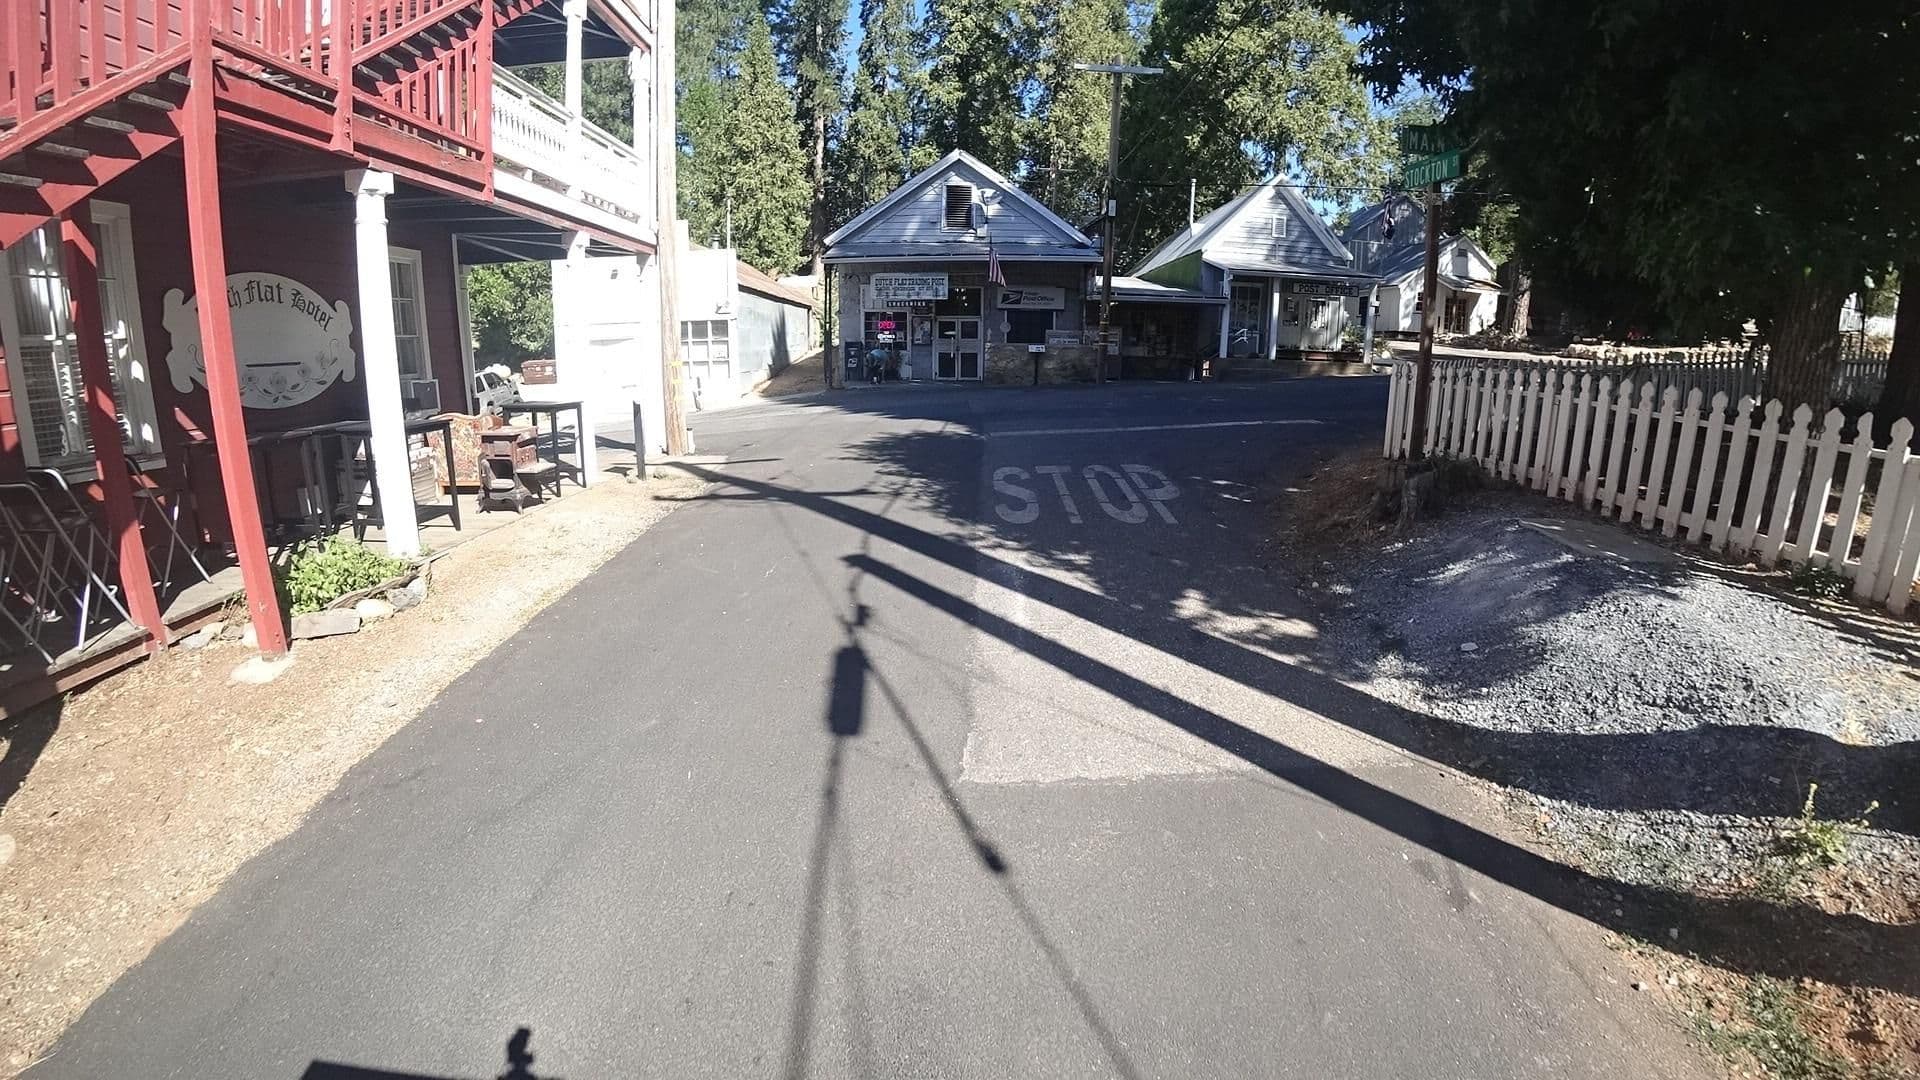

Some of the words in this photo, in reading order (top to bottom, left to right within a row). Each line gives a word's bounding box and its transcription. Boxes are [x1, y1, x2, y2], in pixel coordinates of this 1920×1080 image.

[1404, 160, 1448, 188] STOCKTON
[244, 280, 284, 304] Flat
[1298, 284, 1320, 293] POST
[1325, 285, 1354, 295] OFFICE
[878, 320, 896, 329] OPEN
[992, 463, 1180, 524] STOP
